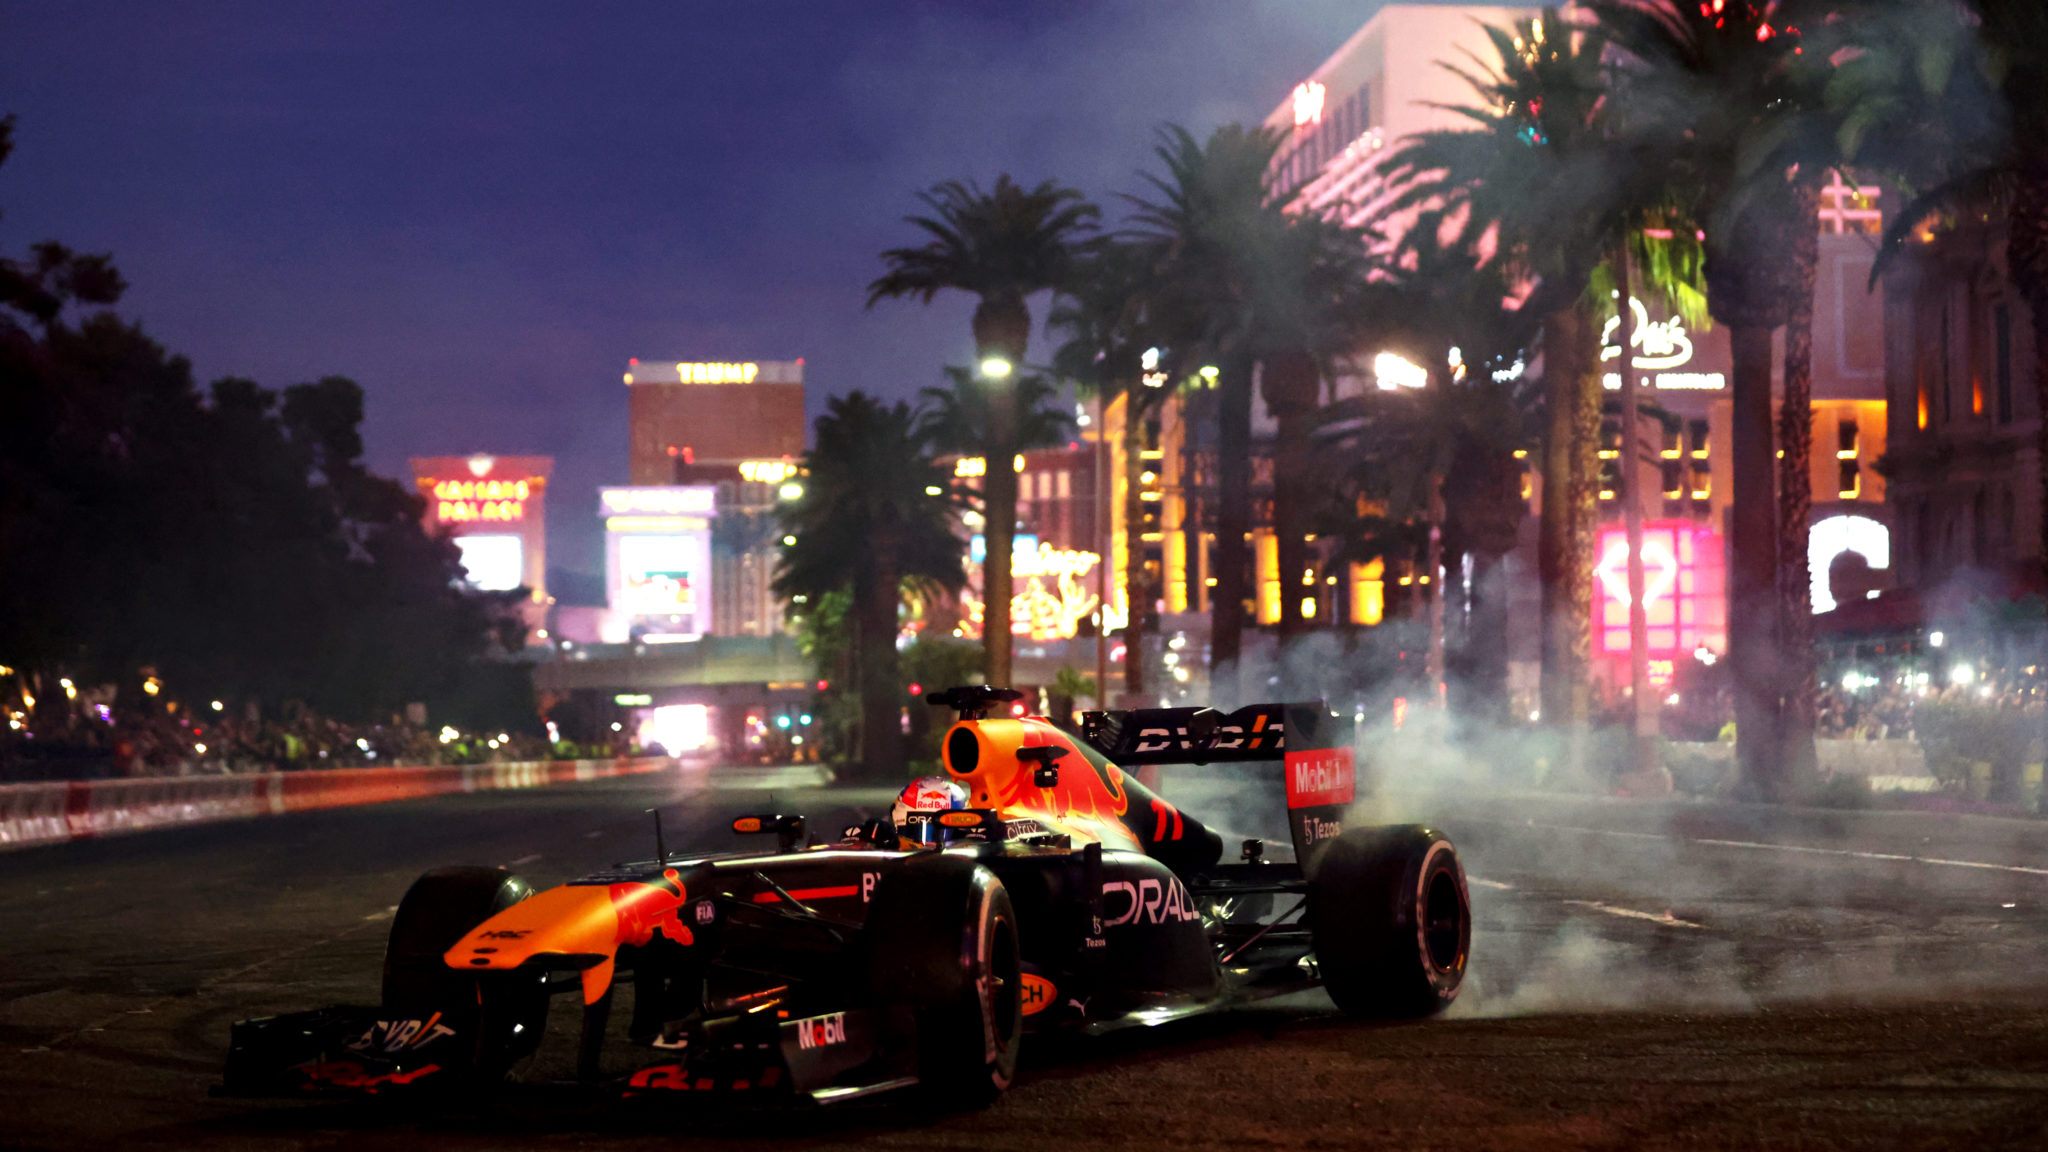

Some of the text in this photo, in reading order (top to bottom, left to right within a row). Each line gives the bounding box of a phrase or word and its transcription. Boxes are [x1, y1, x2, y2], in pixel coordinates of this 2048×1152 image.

[676, 362, 758, 384] TRUMP
[434, 480, 529, 500] CAESARS
[438, 500, 522, 521] PALACE
[1296, 761, 1332, 794] Mobil
[917, 801, 950, 810] Red Bull
[1151, 798, 1184, 842] 11
[1313, 817, 1341, 839] Tezos
[695, 904, 714, 921] FIA
[1086, 937, 1106, 948] Tezos
[798, 1011, 847, 1050] Mobil
